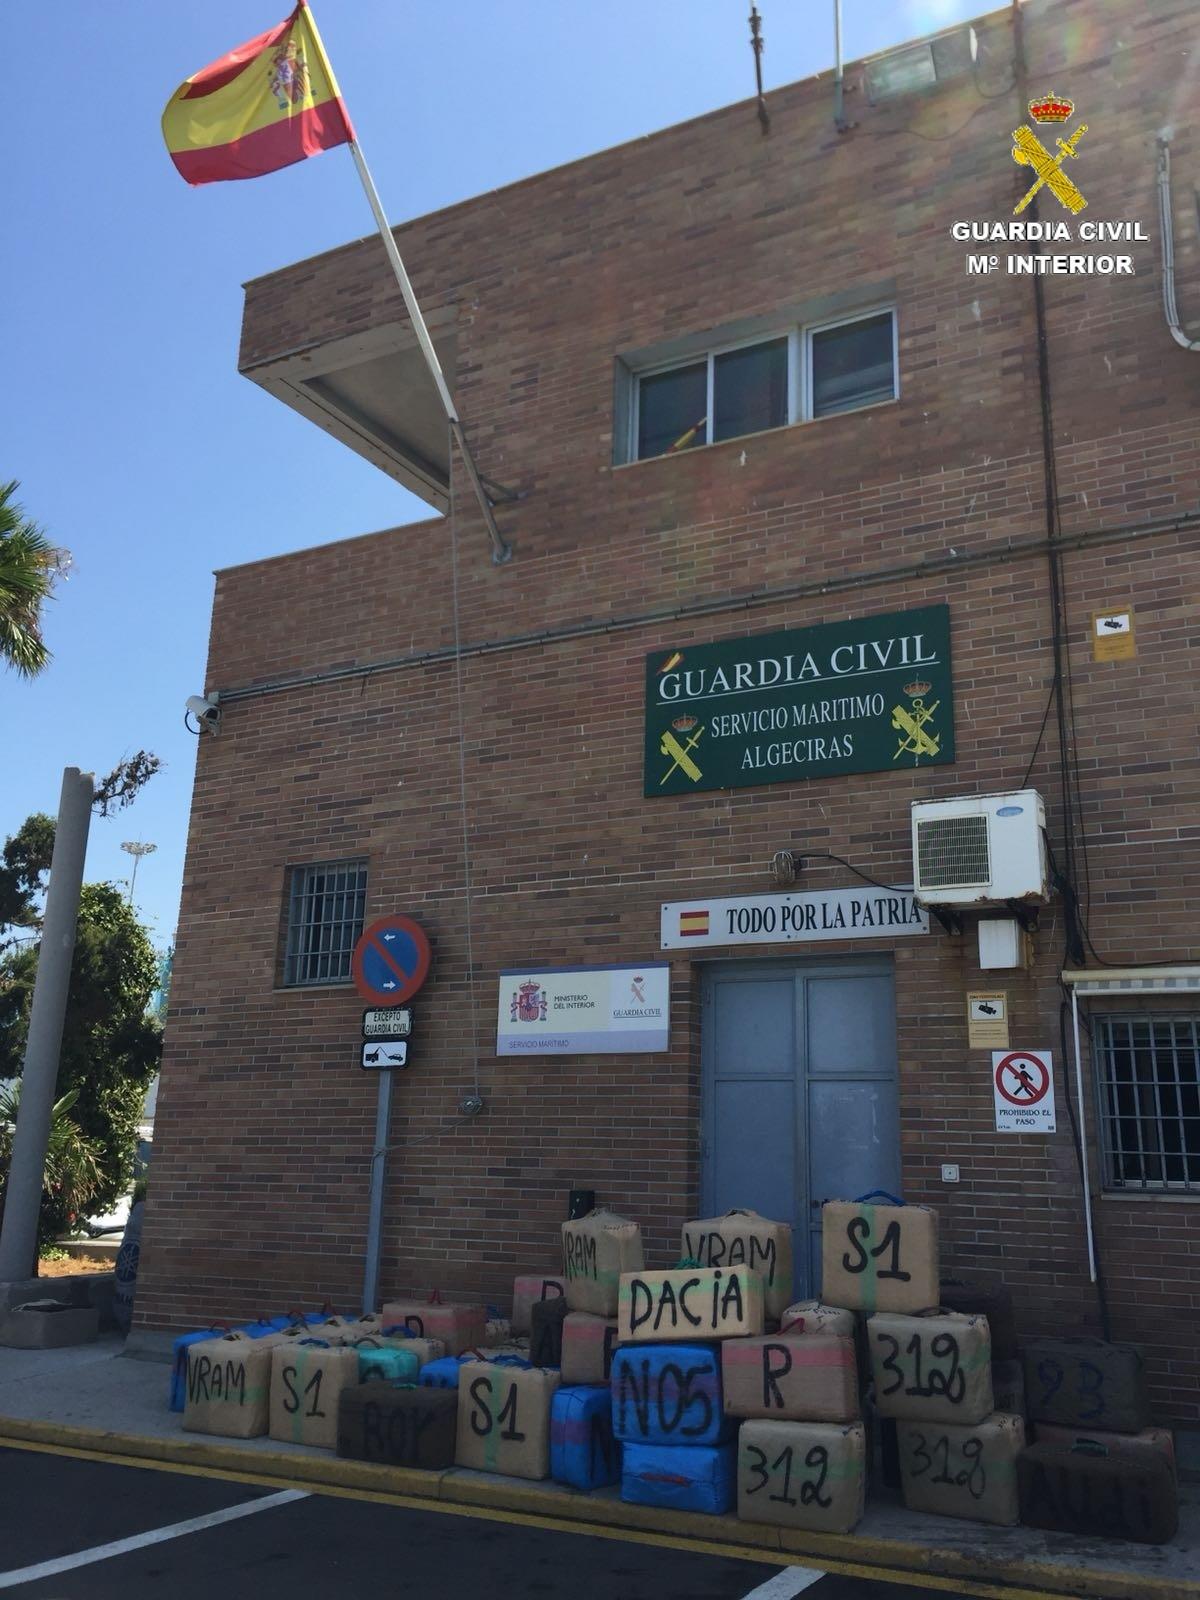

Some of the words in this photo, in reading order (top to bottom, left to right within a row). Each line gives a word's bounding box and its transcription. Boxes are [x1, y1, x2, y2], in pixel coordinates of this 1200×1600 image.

[658, 652, 822, 700] GUARDIA
[830, 634, 937, 674] CIVIL
[710, 705, 789, 738] SERVICIO
[792, 692, 885, 727] MARITIMO
[740, 734, 853, 769] ALGECIRAS
[726, 906, 777, 935] TODO
[780, 903, 817, 931] POR
[820, 901, 846, 930] LA
[851, 896, 922, 929] PATRIA
[373, 1011, 401, 1022] EXCEPTO
[553, 1002, 565, 1010] DEL
[566, 1001, 596, 1009] INTERIOR
[554, 994, 588, 1002] MINISTERIO
[365, 1024, 391, 1034] GUARDIA
[392, 1023, 408, 1033] CIVIL
[842, 1217, 911, 1282] S1
[186, 1355, 246, 1406] VRAM
[281, 1365, 326, 1419] S1
[762, 1343, 793, 1409] R
[470, 1376, 526, 1442] S1
[745, 1445, 832, 1508] 312
